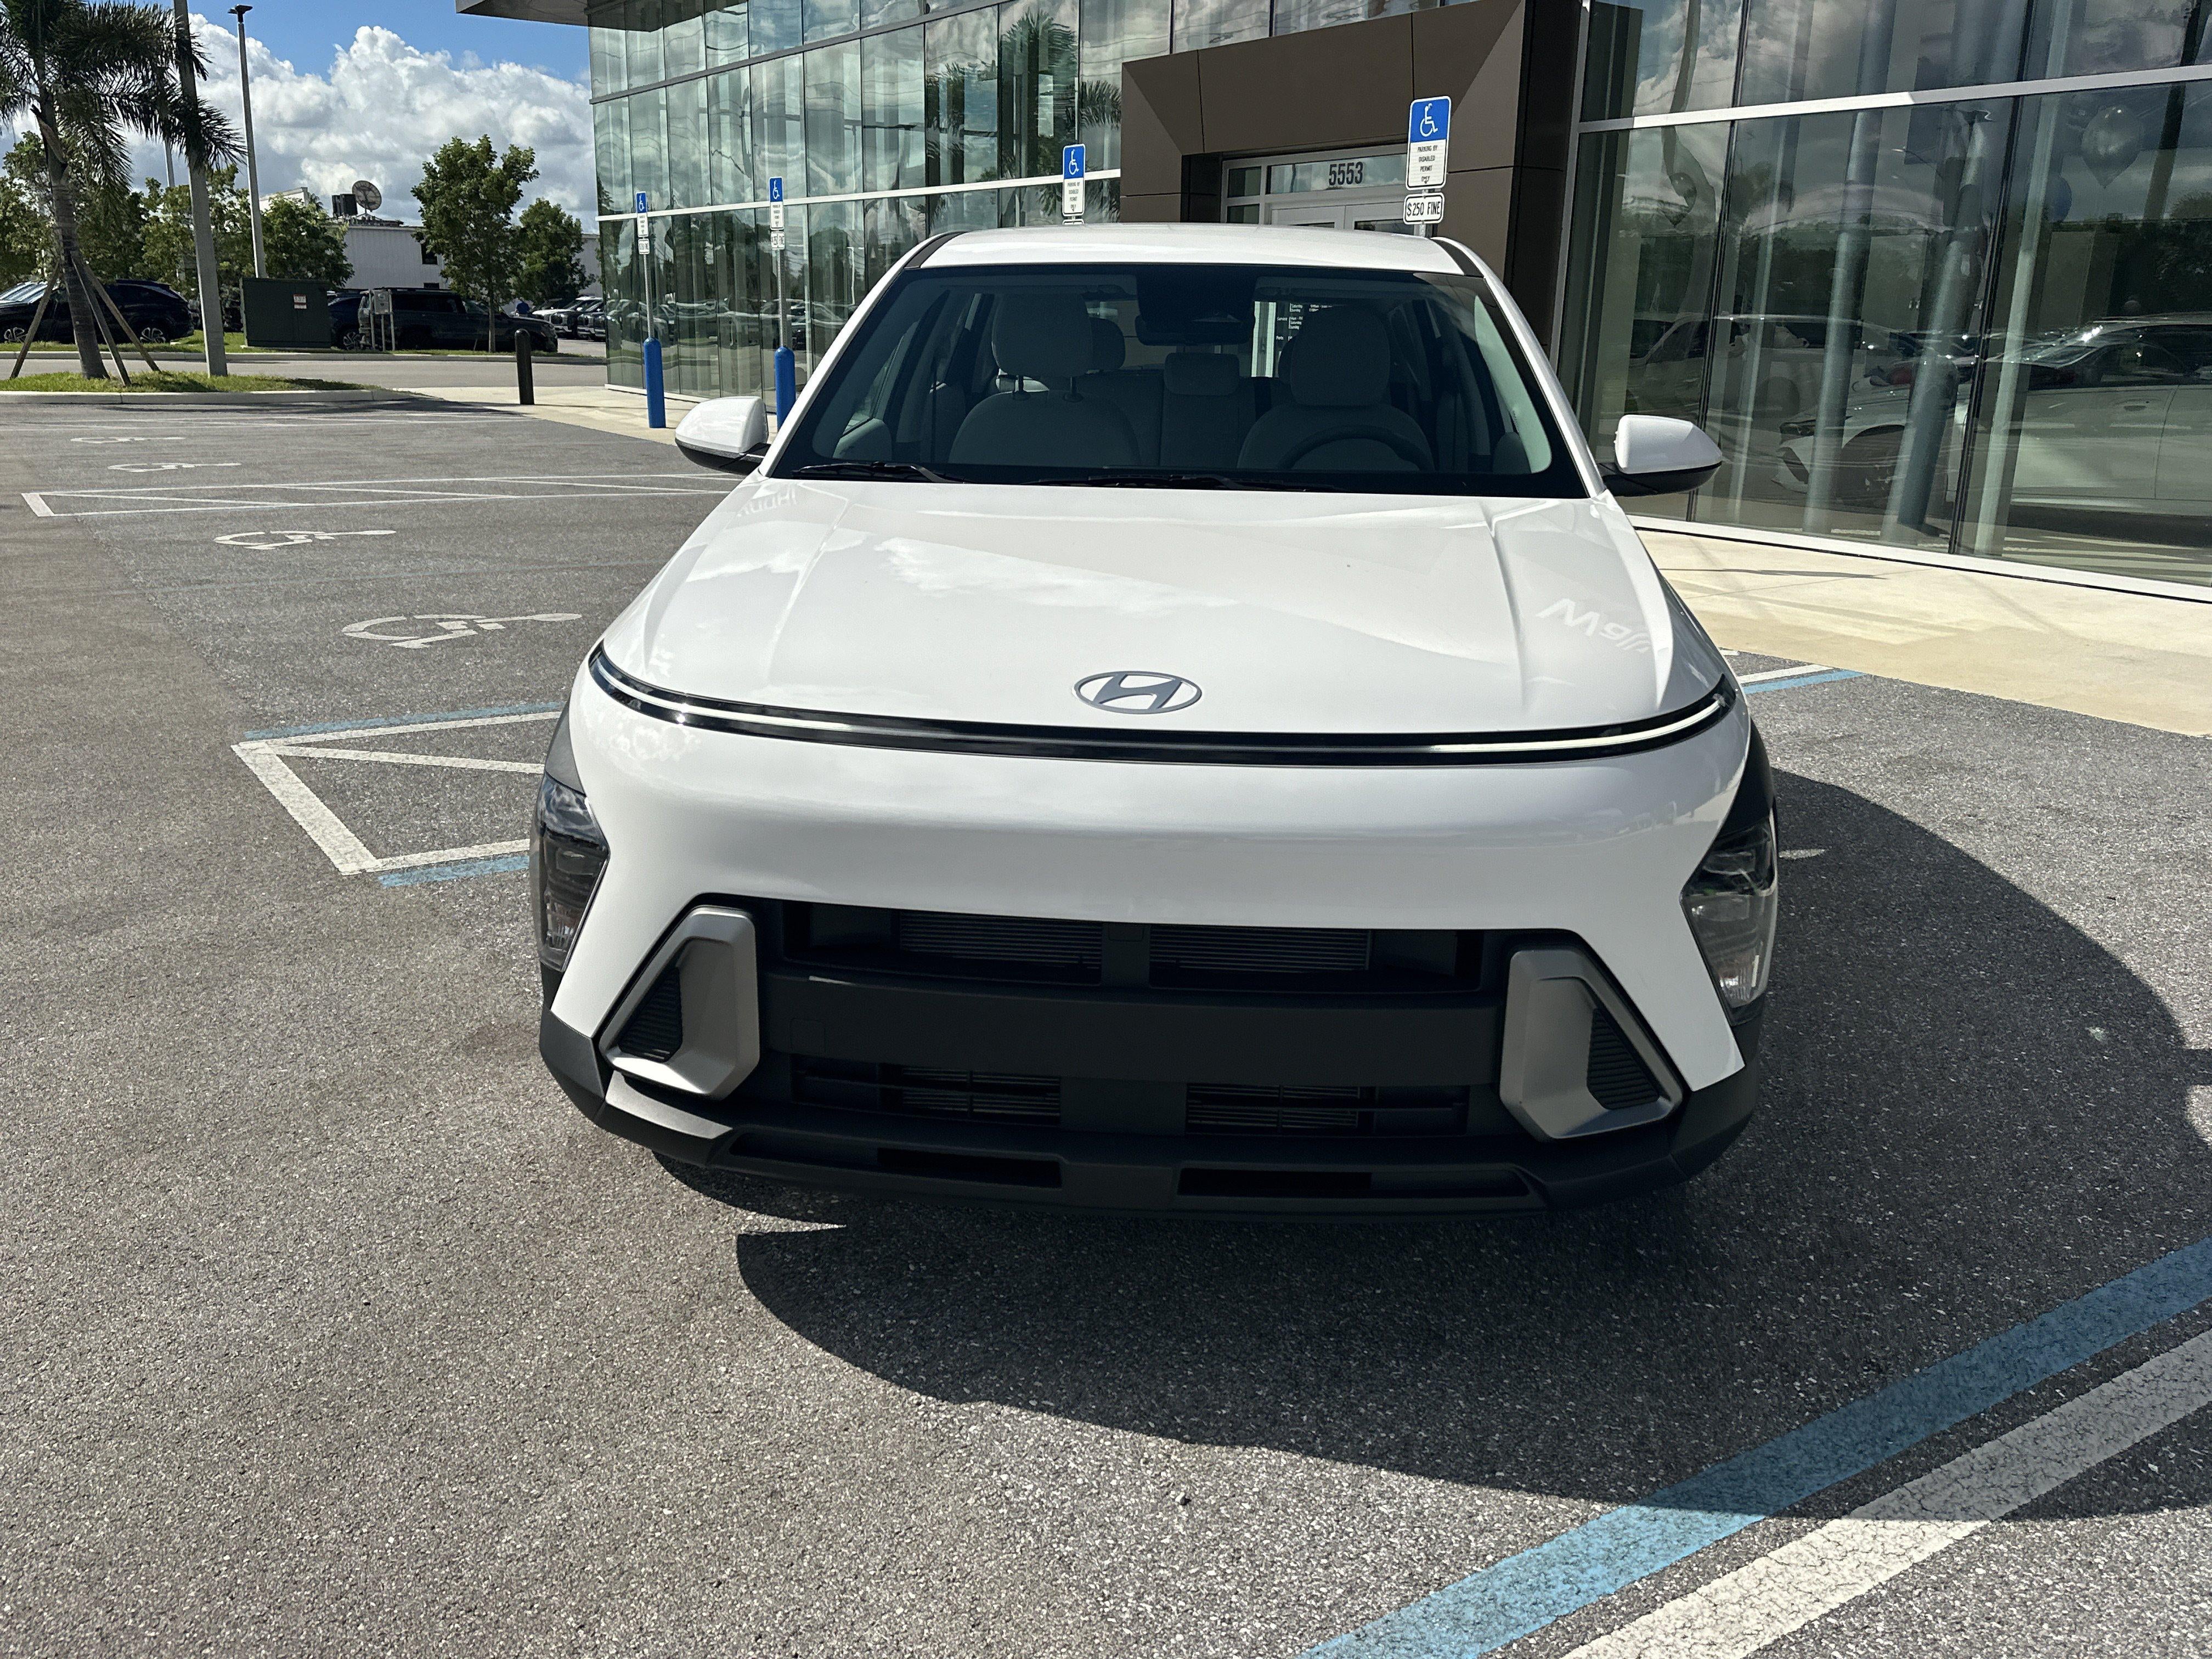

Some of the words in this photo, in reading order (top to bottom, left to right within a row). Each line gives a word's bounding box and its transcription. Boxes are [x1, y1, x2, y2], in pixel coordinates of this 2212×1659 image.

[1329, 162, 1363, 185] 5553
[1407, 202, 1424, 217] $250
[1427, 201, 1441, 215] FINE
